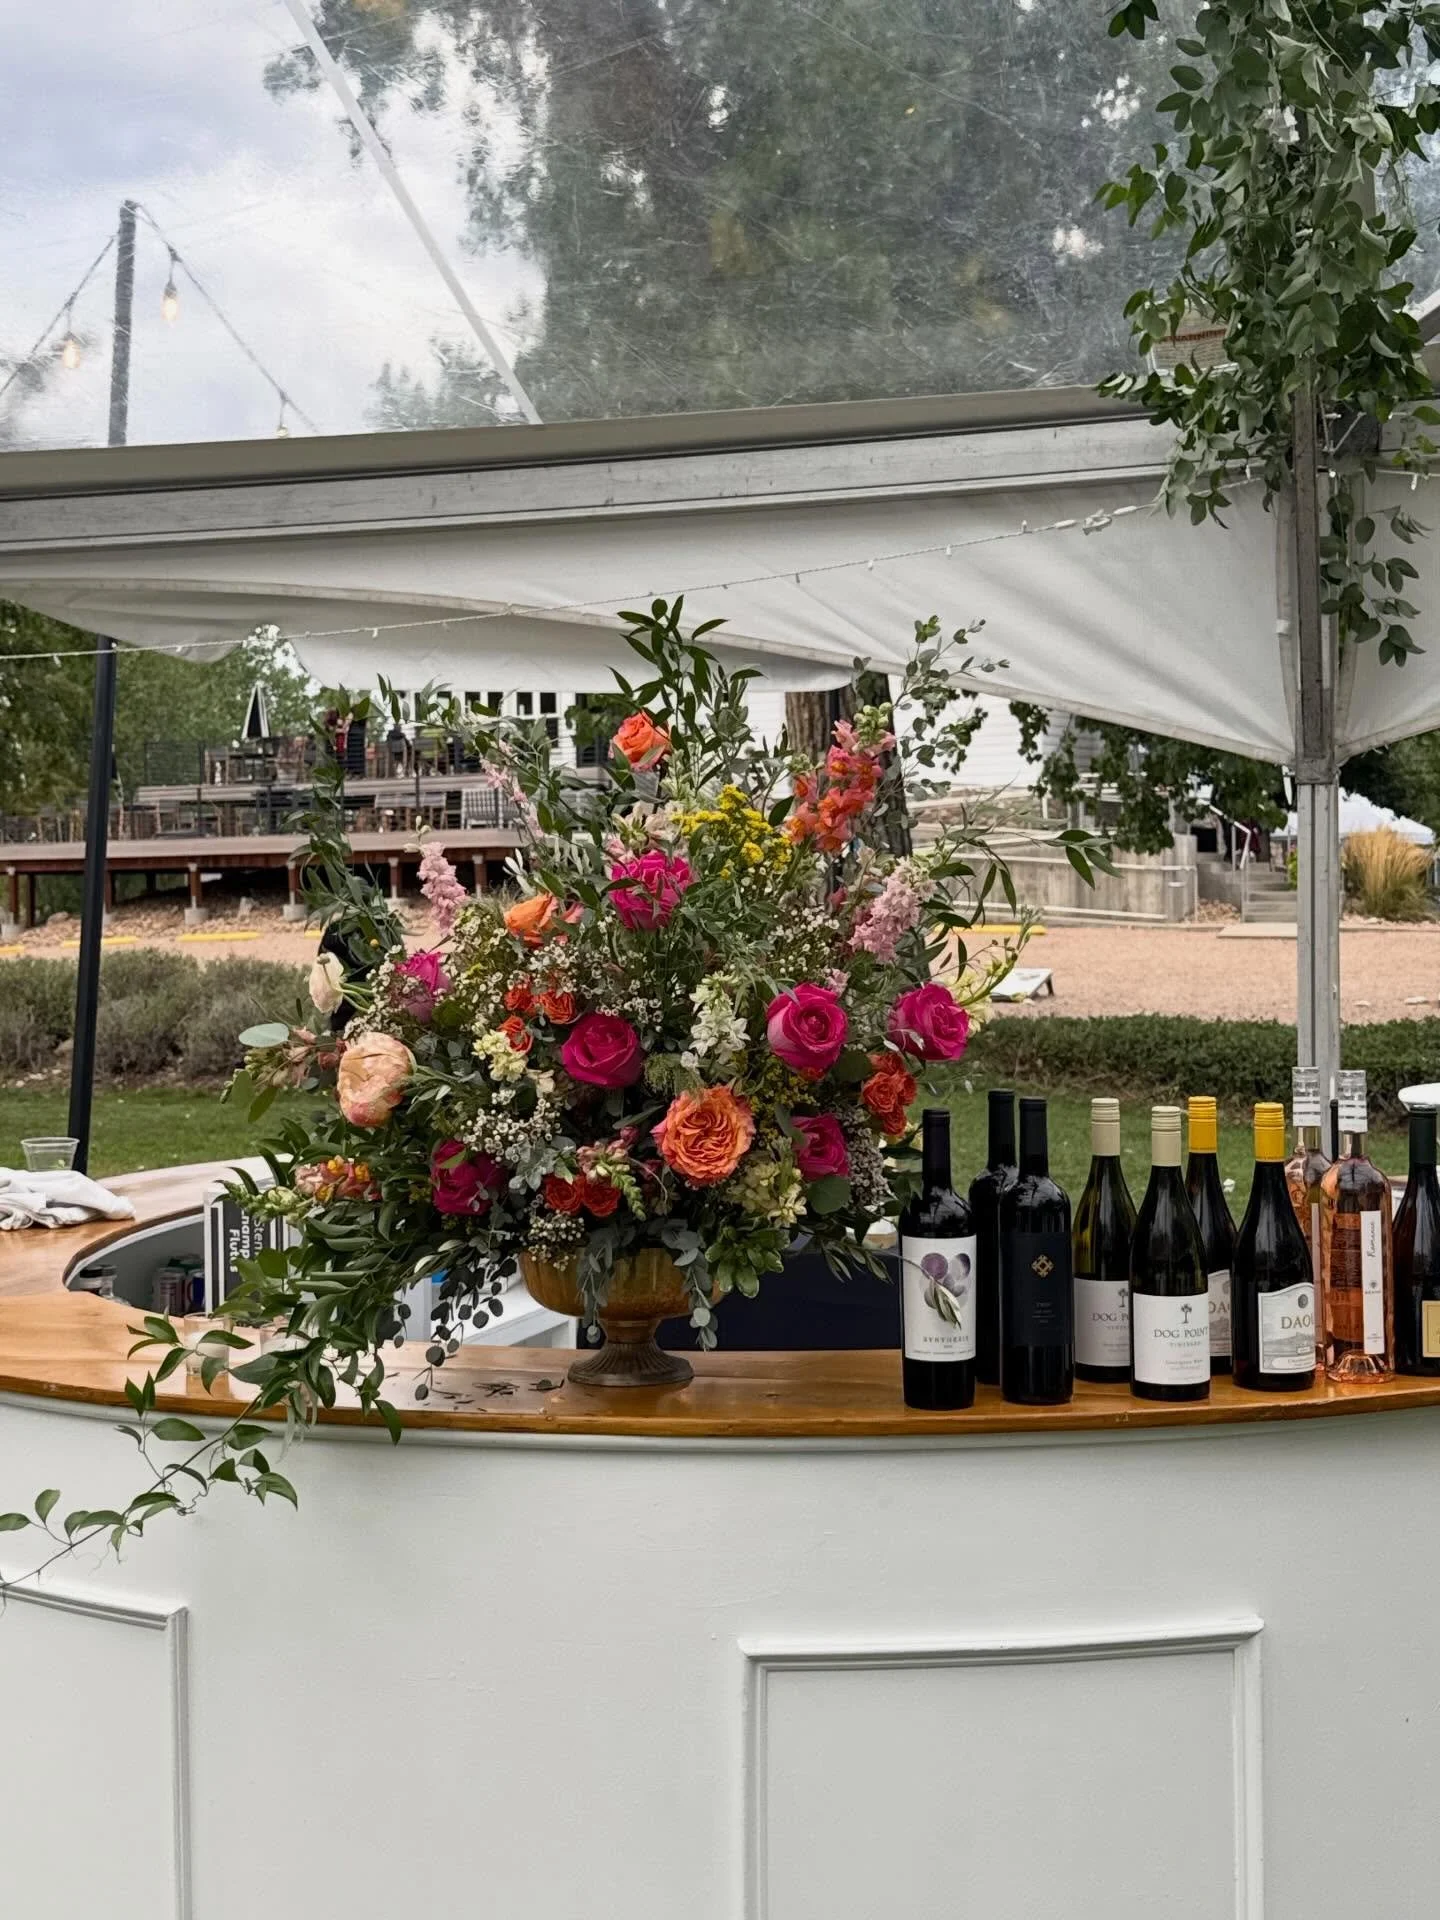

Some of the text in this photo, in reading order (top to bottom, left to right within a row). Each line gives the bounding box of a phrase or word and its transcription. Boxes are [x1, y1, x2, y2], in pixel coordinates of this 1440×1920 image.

[1092, 1312, 1118, 1321] DOG
[1153, 1326, 1209, 1339] DOG POINT
